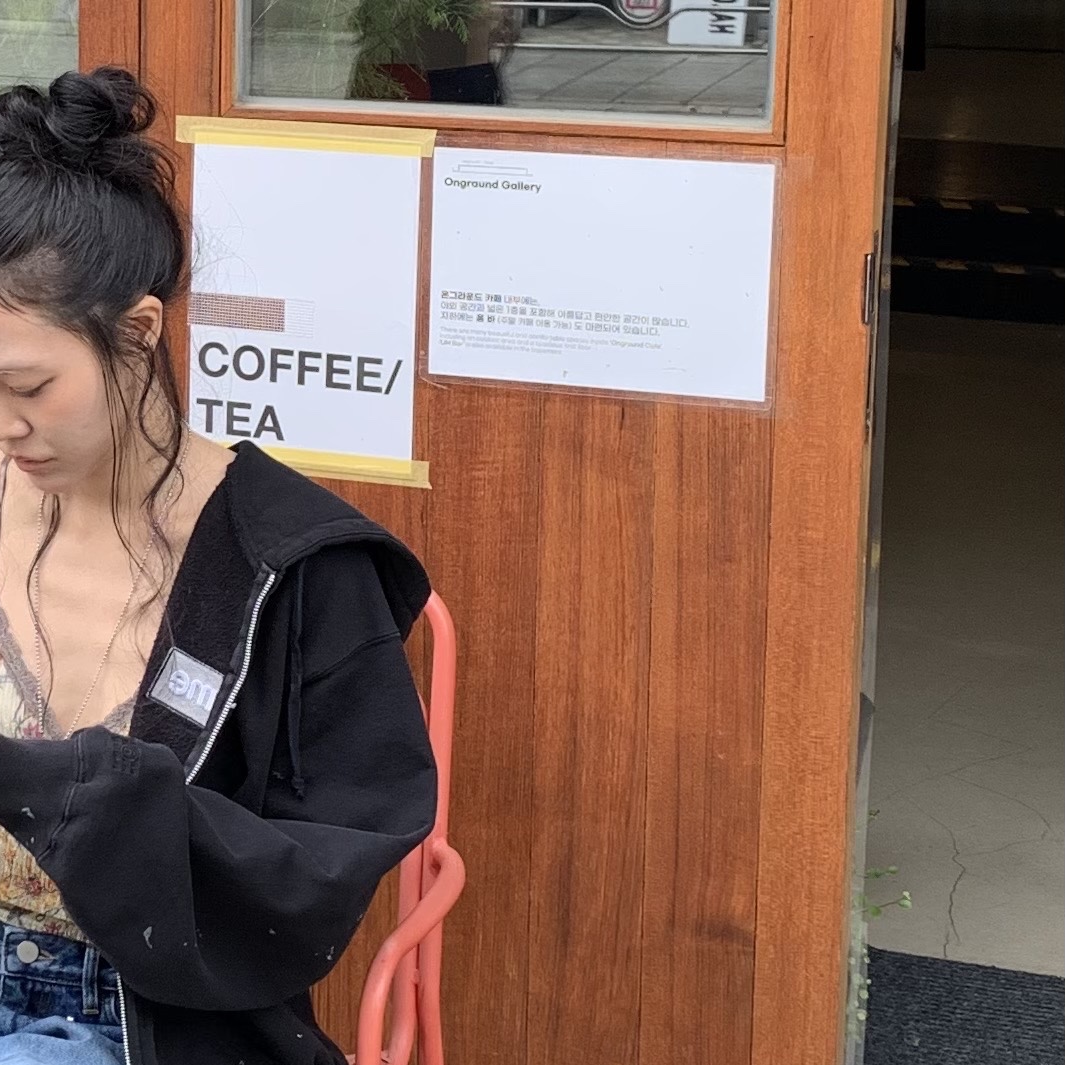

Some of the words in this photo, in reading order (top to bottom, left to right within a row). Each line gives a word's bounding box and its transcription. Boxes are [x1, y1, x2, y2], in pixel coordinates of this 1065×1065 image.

[444, 177, 499, 190] Onground
[501, 180, 542, 194] Gallery
[198, 341, 403, 395] COFFEE/
[196, 397, 285, 441] TEA
